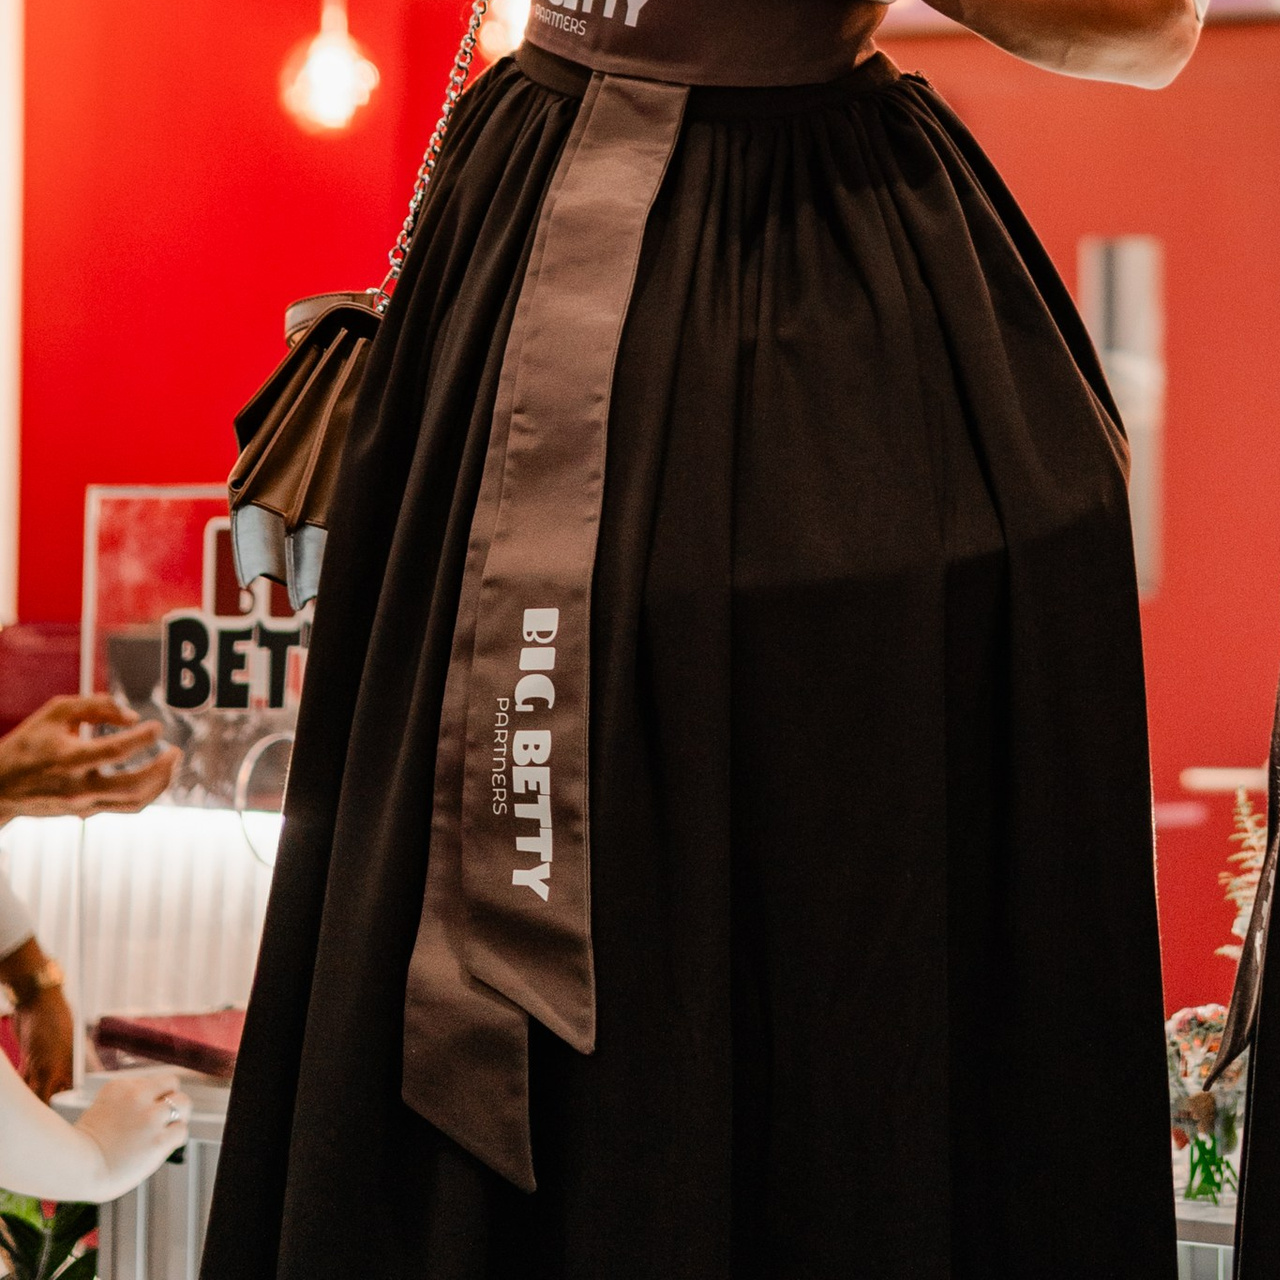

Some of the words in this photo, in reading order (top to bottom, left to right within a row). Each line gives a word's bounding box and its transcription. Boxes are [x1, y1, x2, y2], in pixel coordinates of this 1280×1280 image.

[536, 3, 587, 36] PARTNERS
[165, 617, 311, 708] BET
[514, 607, 559, 712] BIG
[491, 697, 510, 816] PARTNERS
[511, 730, 553, 903] BETTY
